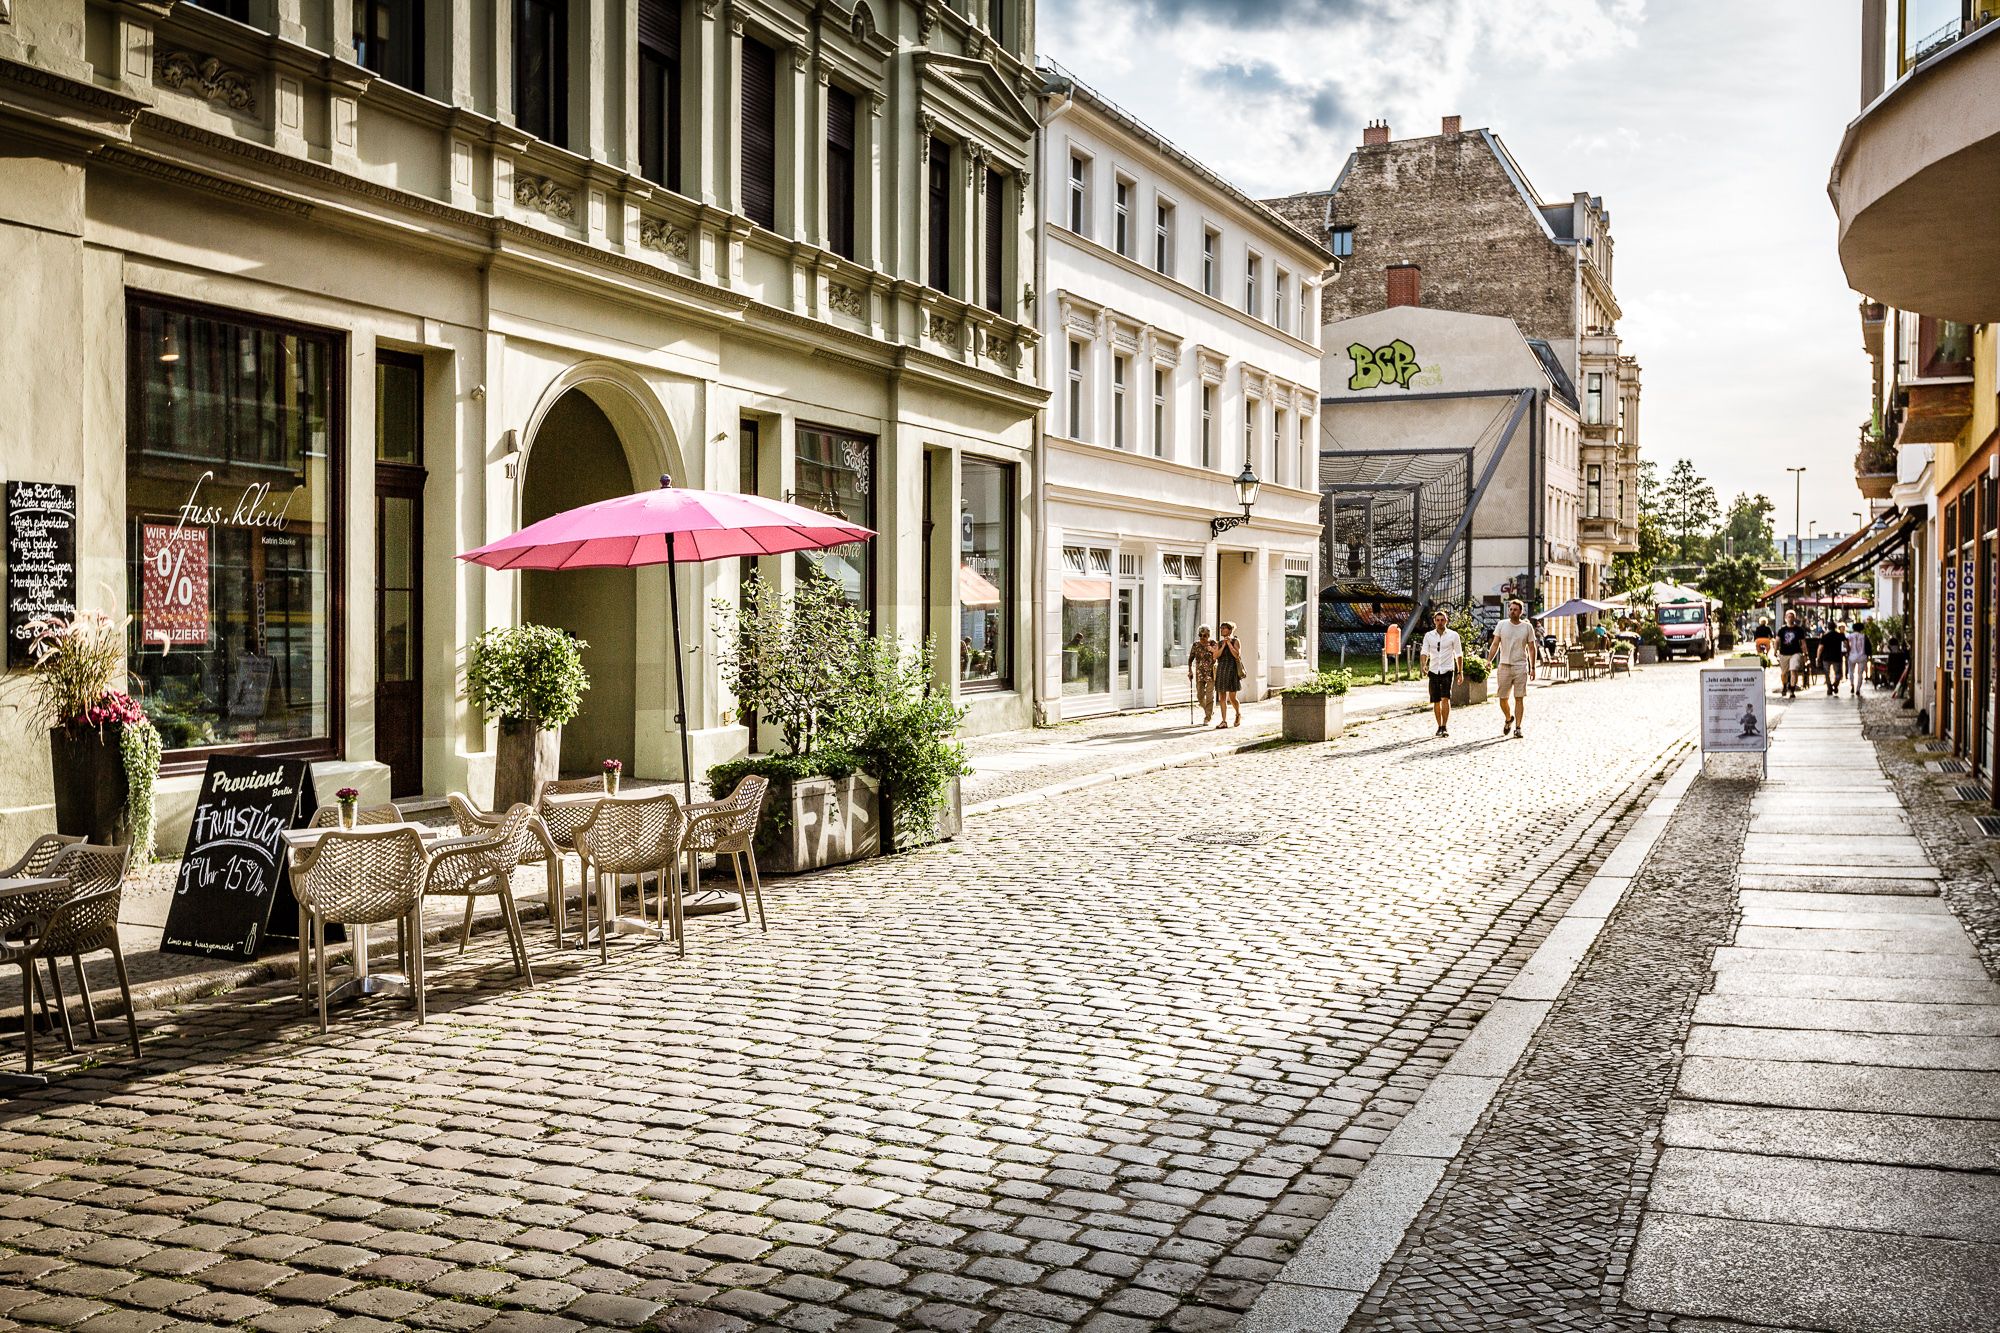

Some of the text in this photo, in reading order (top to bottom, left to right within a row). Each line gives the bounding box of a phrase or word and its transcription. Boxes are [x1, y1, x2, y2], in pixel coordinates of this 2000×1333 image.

[146, 527, 206, 541] WIR HABEN
[262, 536, 278, 545] Katrin
[1963, 562, 1974, 678] HÖRGERÄTE
[211, 765, 285, 793] Proviant
[271, 786, 293, 798] Berlin
